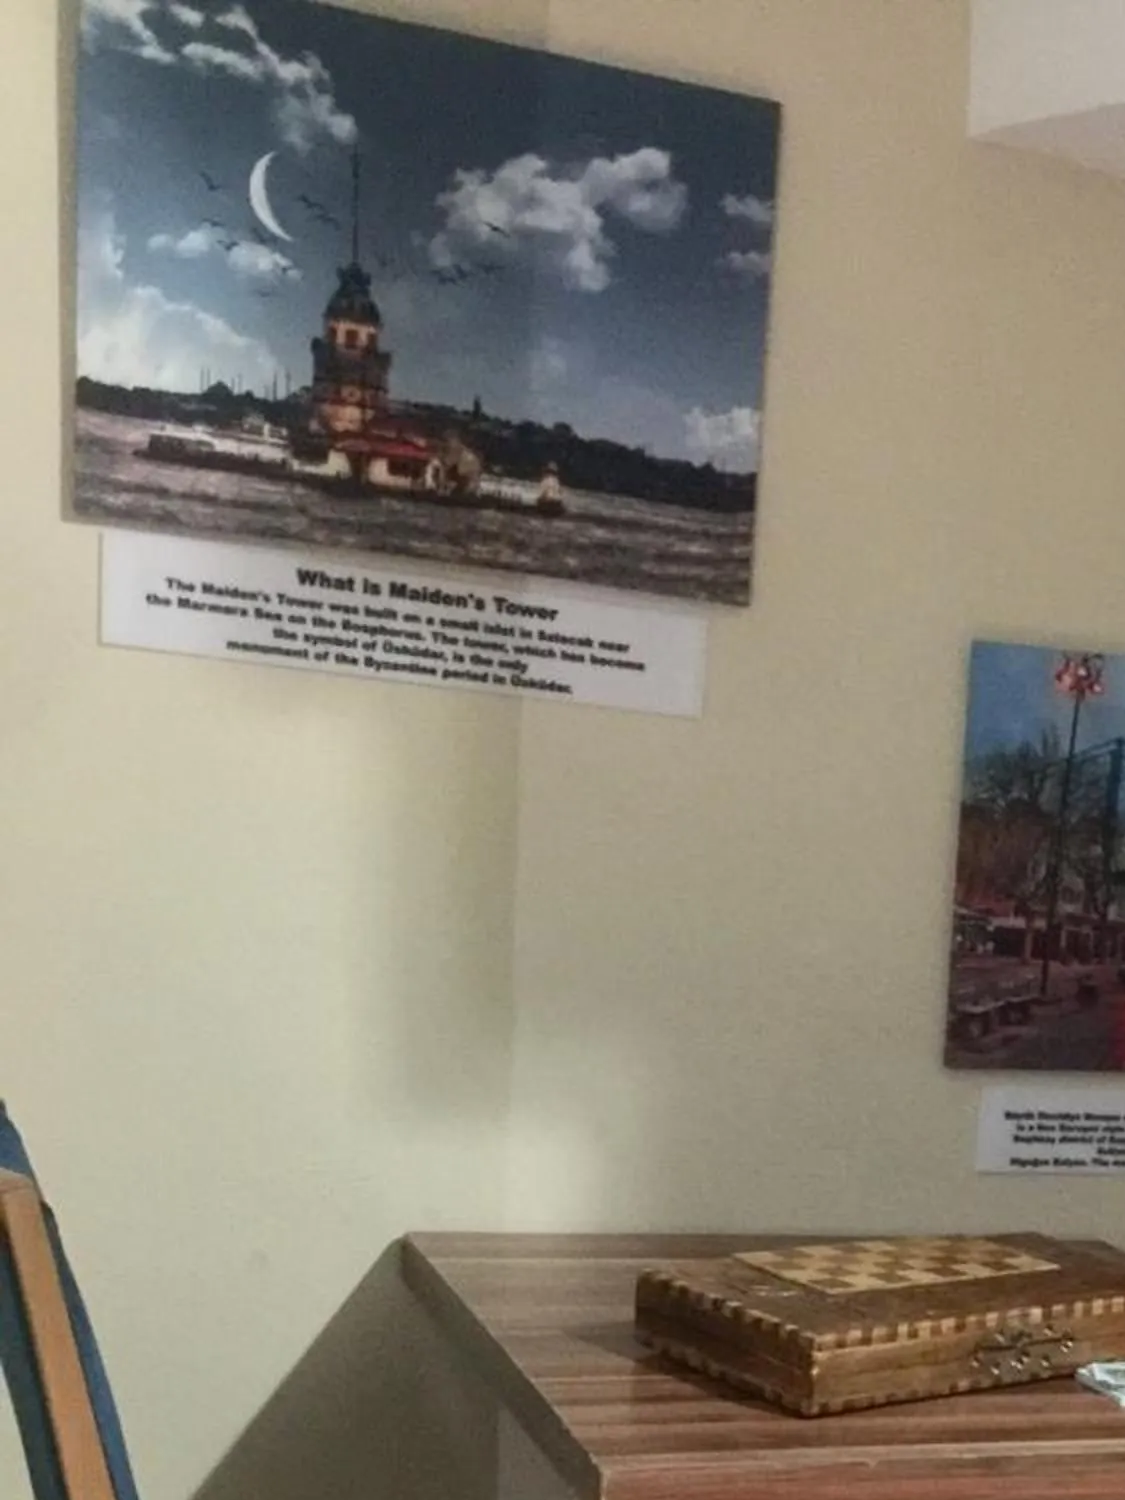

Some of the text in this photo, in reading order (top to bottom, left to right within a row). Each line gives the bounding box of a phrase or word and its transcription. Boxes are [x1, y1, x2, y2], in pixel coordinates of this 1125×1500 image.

[145, 593, 171, 606] the
[312, 616, 336, 628] the
[432, 632, 459, 646] The
[164, 577, 195, 592] The
[202, 581, 271, 603] Maiden's
[277, 592, 323, 609] Tower
[296, 567, 559, 621] What is Maiden's Tower
